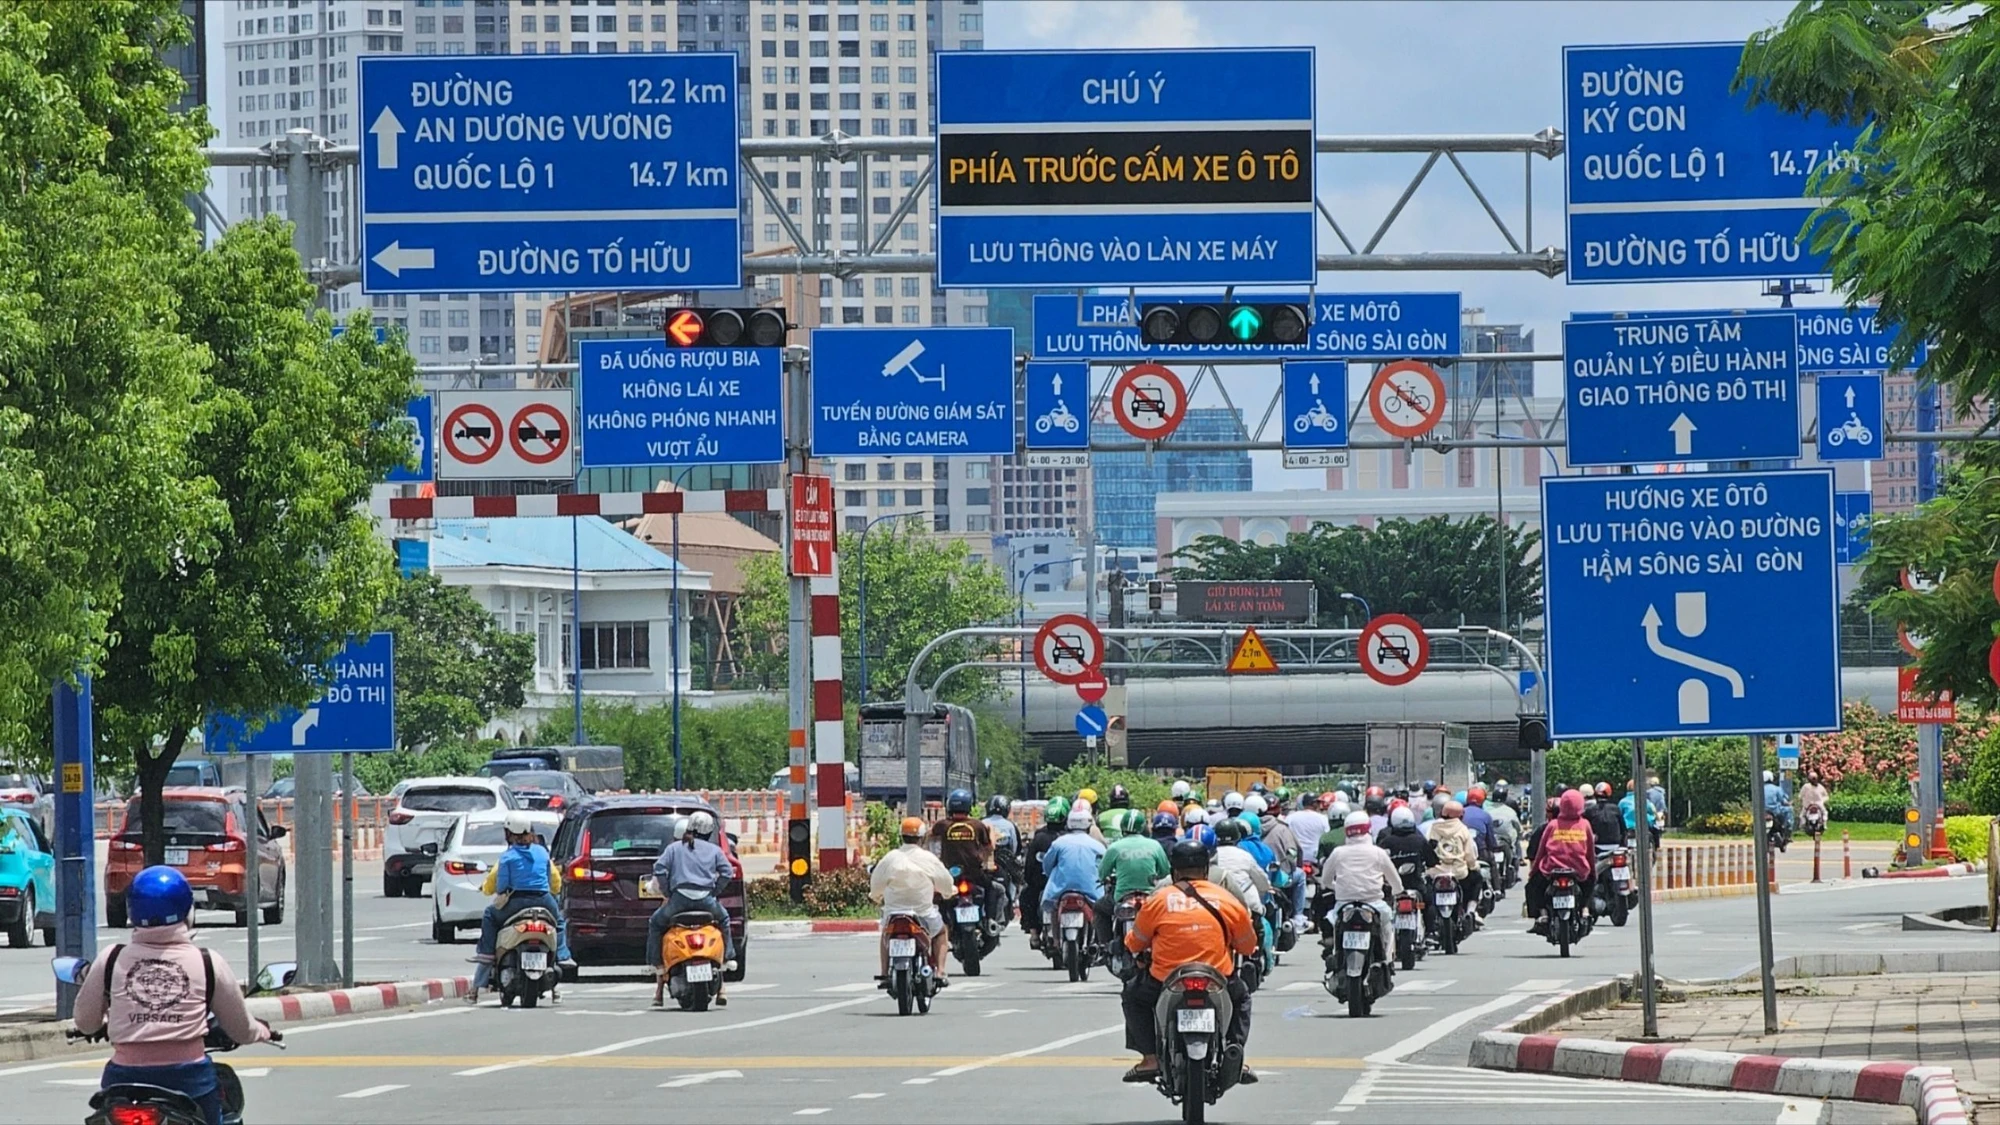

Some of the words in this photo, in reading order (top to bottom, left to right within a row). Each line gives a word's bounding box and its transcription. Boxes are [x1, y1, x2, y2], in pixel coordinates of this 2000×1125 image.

[410, 72, 512, 106] ĐƯỜNG
[628, 78, 676, 104] 12.2
[684, 78, 726, 104] km
[1082, 70, 1140, 104] CHÚ
[1148, 72, 1166, 104] Ý
[1582, 64, 1684, 98] ĐƯỜNG
[414, 118, 454, 142] AN
[466, 112, 564, 142] DƯƠNG
[572, 112, 672, 140] VƯƠNG
[1584, 102, 1620, 134] KÝ
[1628, 106, 1686, 132] CON
[414, 152, 492, 190] QUỐC
[500, 156, 536, 194] LỘ
[544, 164, 554, 188] 1
[630, 162, 678, 186] 14.7
[686, 162, 728, 186] km
[950, 152, 1016, 184] PHÍA
[1024, 148, 1116, 182] TRƯỚC
[1124, 146, 1184, 182] CẤM
[1194, 156, 1228, 180] XE
[1238, 150, 1256, 180] Ô
[1264, 148, 1298, 180] TÔ
[1584, 144, 1662, 180] QUỐC
[1670, 146, 1706, 182] LỘ
[1716, 152, 1724, 176] 1
[1770, 149, 1819, 176] 14.7
[478, 240, 580, 276] ĐƯỜNG
[588, 236, 624, 274] TỐ
[632, 240, 690, 272] HỮU
[970, 240, 1014, 262] LƯU
[1020, 238, 1094, 262] THÔNG
[1100, 236, 1140, 262] VÀO
[1148, 236, 1190, 260] LÀN
[1198, 240, 1226, 260] XE
[1232, 234, 1278, 260] MÁY
[1584, 234, 1686, 266] ĐƯỜNG
[1694, 228, 1730, 264] TỐ
[1740, 232, 1802, 262] HỮU
[1322, 304, 1344, 322] XE
[1350, 300, 1400, 322] MÔTÔ
[1614, 324, 1688, 346] TRUNG
[1694, 320, 1740, 342] TÂM
[1800, 315, 1853, 336] HÔNG
[1046, 334, 1084, 352] LƯU
[1316, 330, 1366, 350] SÔNG
[1372, 330, 1402, 350] SÀI
[1408, 328, 1446, 350] GÒN
[600, 350, 624, 370] ĐÃ
[628, 348, 676, 368] UỐNG
[680, 350, 728, 370] RƯỢU
[732, 350, 760, 366] BIA
[1574, 352, 1632, 378] QUẢN
[1640, 352, 1666, 374] LÝ
[1670, 346, 1720, 374] ĐIỀU
[1726, 348, 1786, 372] HÀNH
[1799, 345, 1834, 364] ÔNG
[1840, 343, 1869, 364] SÀI
[622, 380, 682, 398] KHÔNG
[686, 378, 714, 396] LÁI
[718, 380, 740, 396] XE
[1580, 386, 1628, 406] GIAO
[1634, 380, 1710, 404] THÔNG
[1716, 378, 1746, 400] ĐÔ
[1752, 380, 1786, 402] THỊ
[588, 410, 646, 430] KHÔNG
[652, 408, 710, 428] PHÓNG
[716, 410, 776, 426] NHANH
[822, 400, 870, 420] TUYẾN
[876, 402, 930, 420] ĐƯỜNG
[934, 402, 972, 420] GIÁM
[976, 400, 1006, 420] SÁT
[646, 440, 690, 460] VƯỢT
[696, 434, 718, 456] ẨU
[858, 426, 902, 446] BẰNG
[906, 432, 968, 446] CAMERA
[1030, 456, 1050, 464] 4:00
[1060, 456, 1085, 464] 23:00
[1288, 456, 1309, 464] 4:00
[1320, 456, 1344, 464] 23:00
[1606, 484, 1684, 510] HƯỚNG
[1692, 488, 1720, 508] XE
[1726, 482, 1768, 506] ÔTÔ
[1558, 522, 1602, 544] LƯU
[1608, 518, 1684, 542] THÔNG
[1690, 516, 1734, 540] VÀO
[1740, 512, 1820, 538] ĐƯỜNG
[1640, 552, 1700, 576] SÔNG
[1706, 548, 1742, 574] SÀI
[1756, 546, 1802, 572] GÒN
[1224, 601, 1236, 611] XE
[1240, 601, 1254, 611] AN
[335, 659, 384, 678] HÀNH
[328, 684, 352, 703] ĐÔ
[357, 687, 385, 705] THỊ
